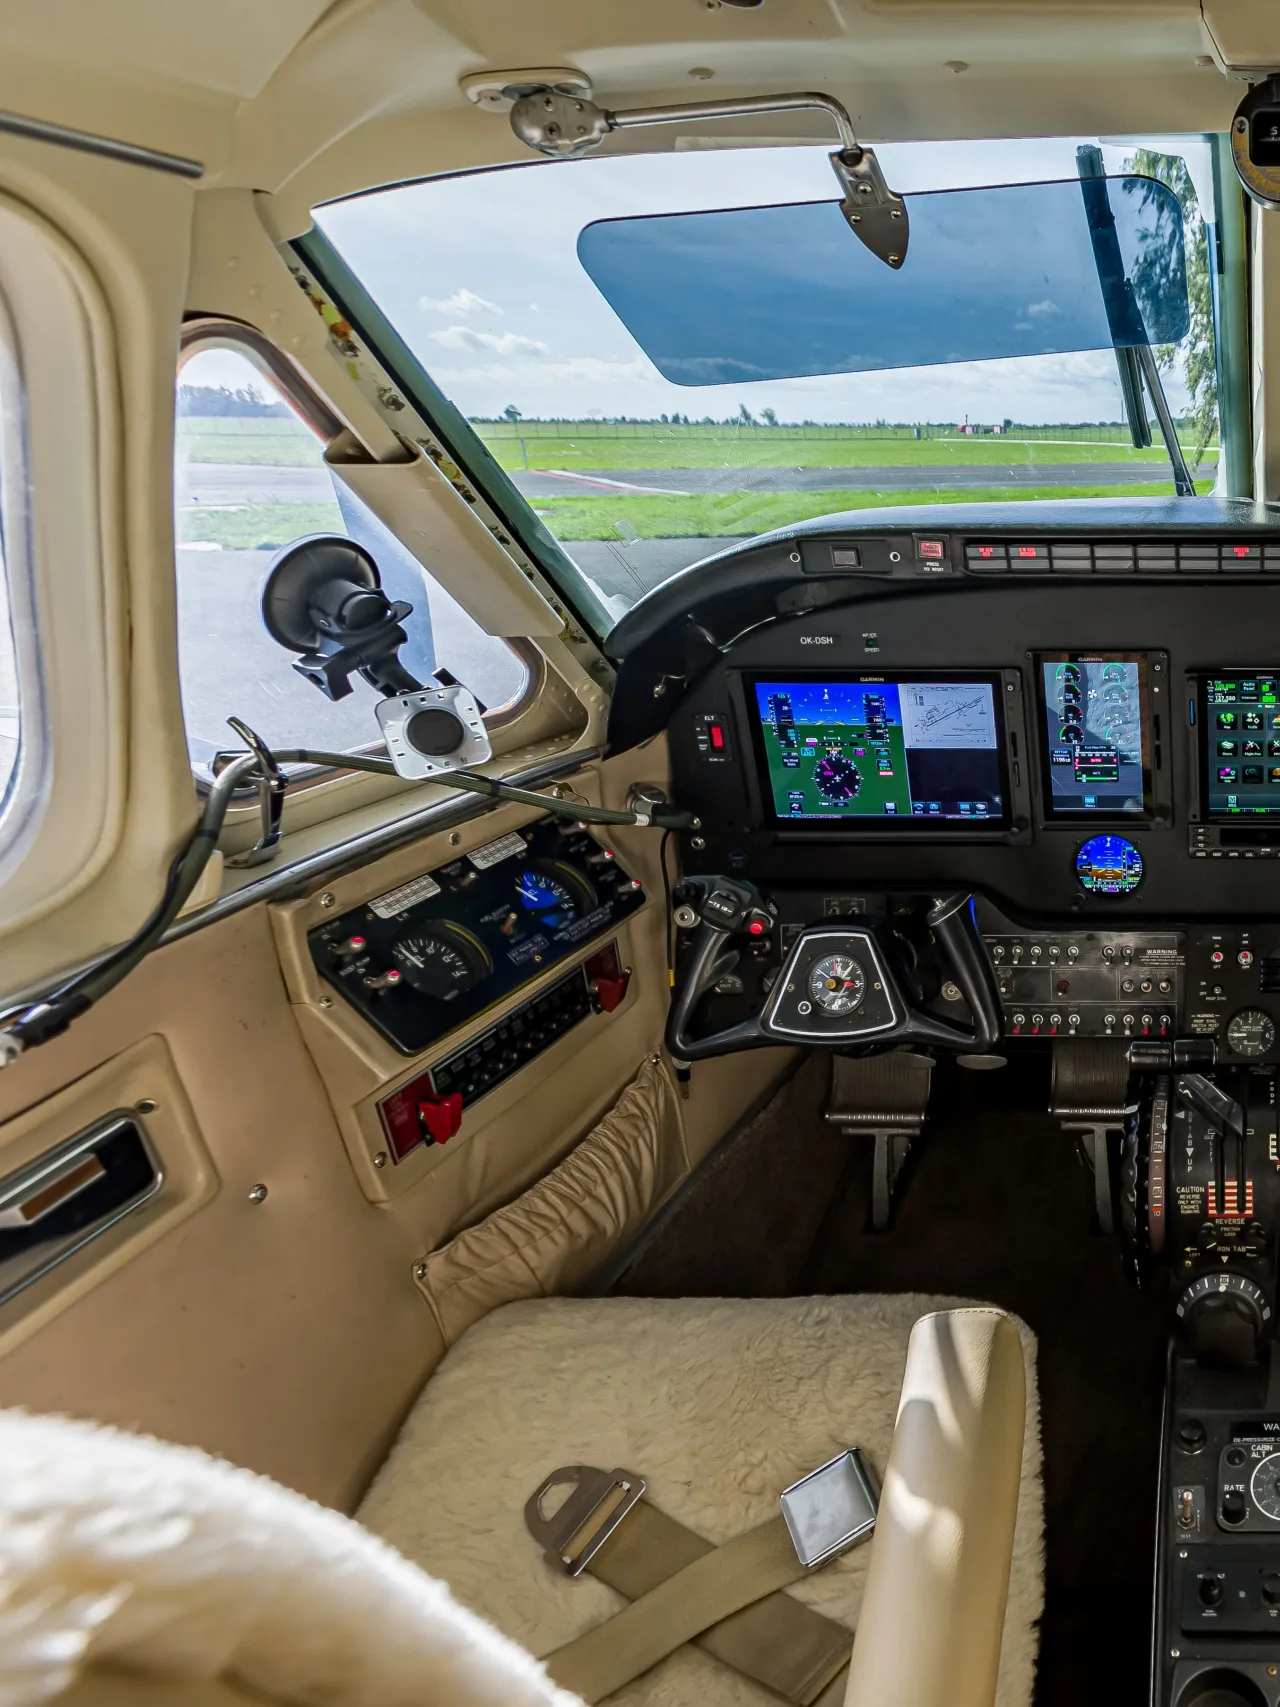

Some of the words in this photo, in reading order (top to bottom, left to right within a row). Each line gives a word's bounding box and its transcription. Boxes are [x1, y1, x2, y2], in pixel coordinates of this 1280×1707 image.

[800, 636, 833, 644] OK-DSH
[1176, 1186, 1205, 1194] CAUTION
[1224, 1484, 1245, 1492] RATE
